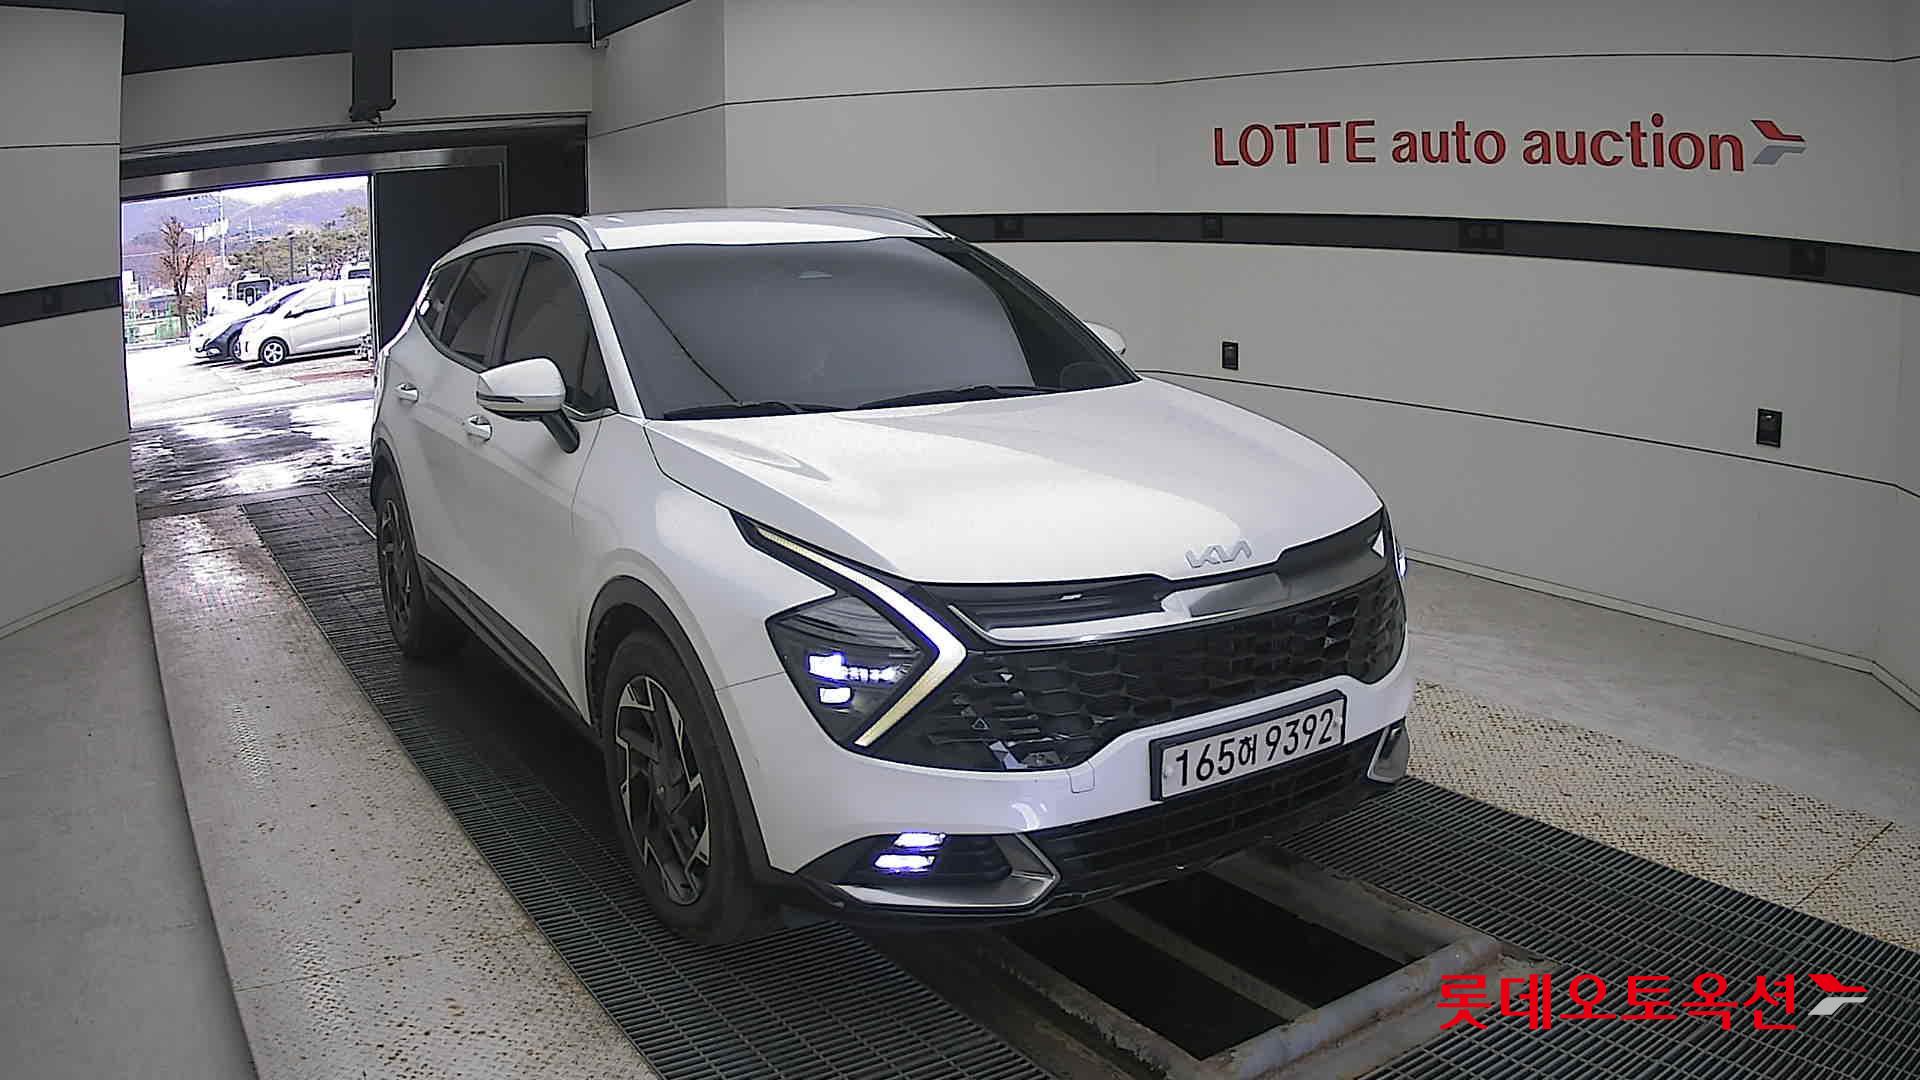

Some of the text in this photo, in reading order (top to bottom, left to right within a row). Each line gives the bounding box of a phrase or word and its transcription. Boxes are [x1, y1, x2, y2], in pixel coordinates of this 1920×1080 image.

[1213, 112, 1745, 172] LOTTE auto auction
[1184, 540, 1252, 569] KIA
[1175, 707, 1335, 787] 165허 9392
